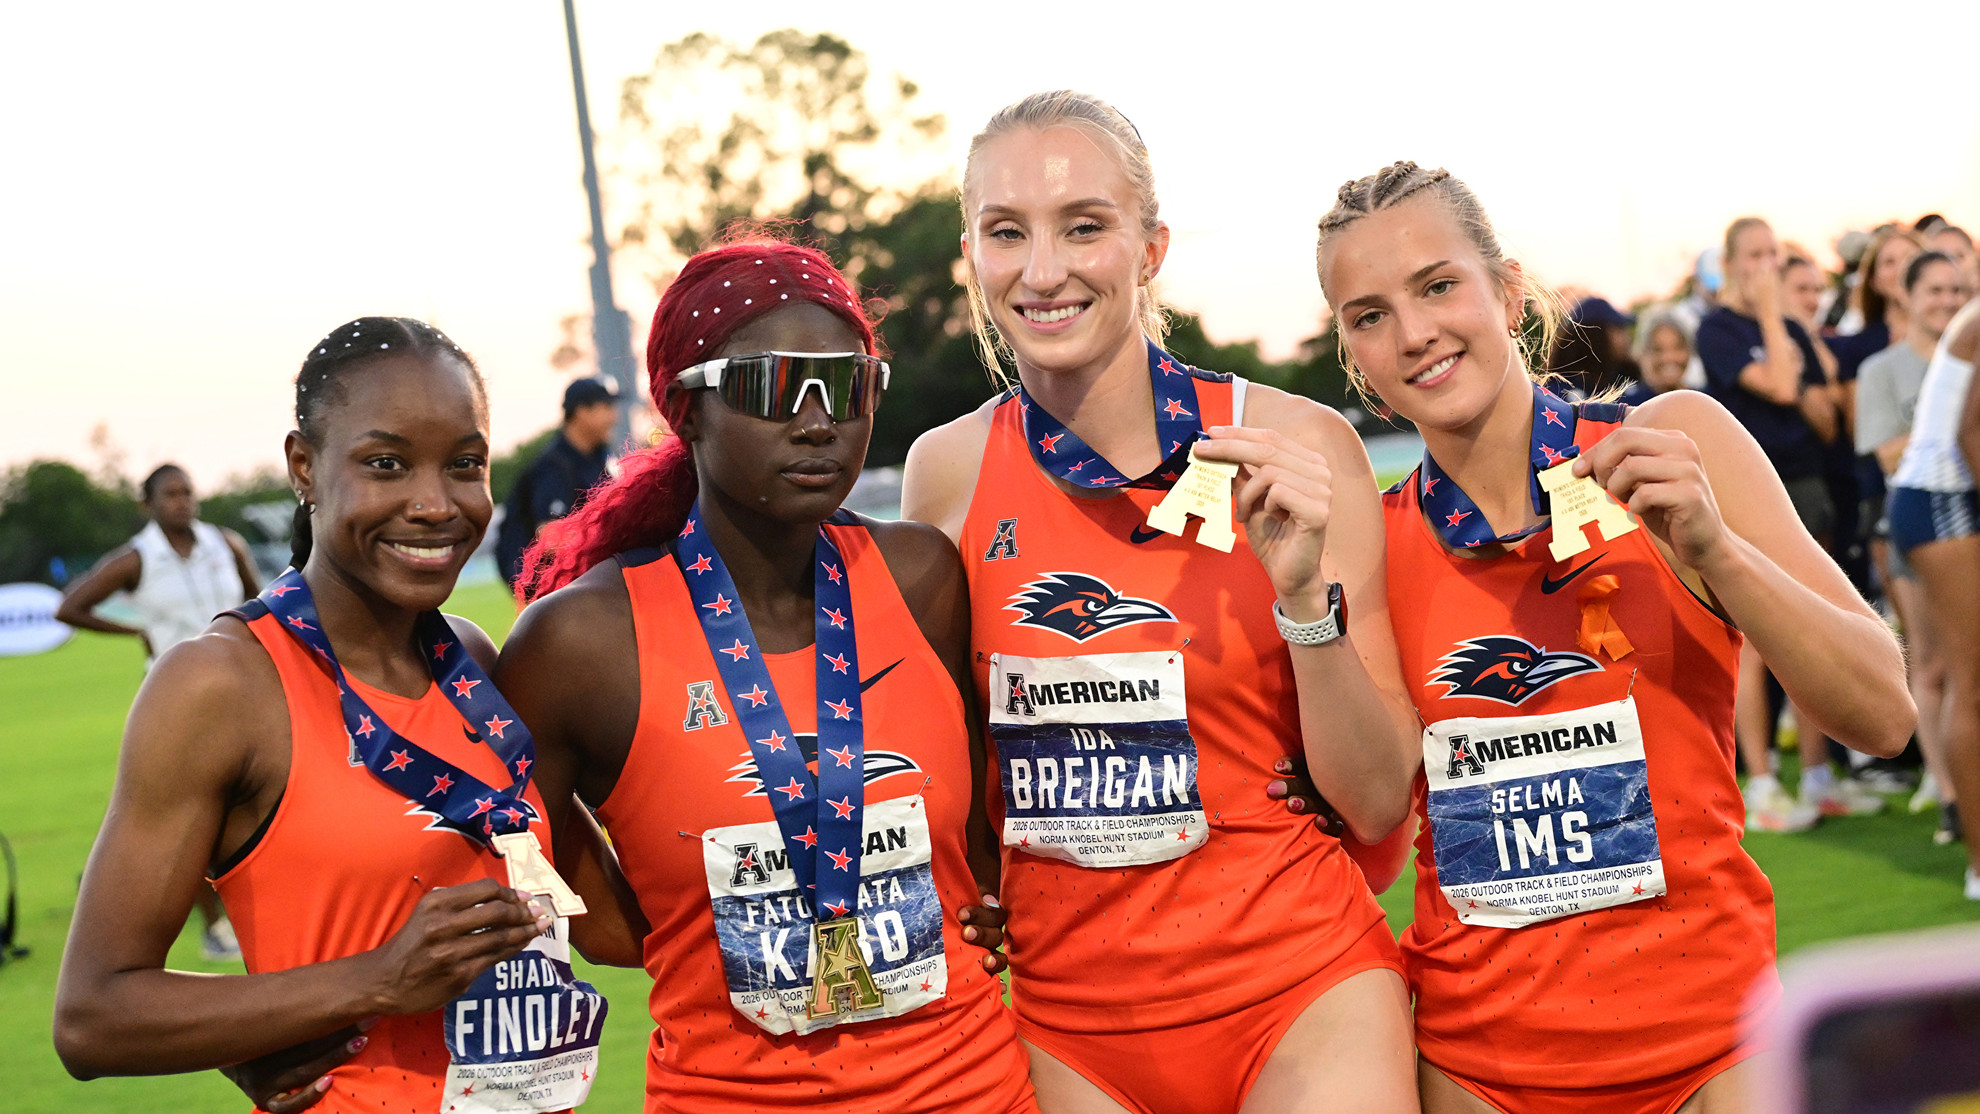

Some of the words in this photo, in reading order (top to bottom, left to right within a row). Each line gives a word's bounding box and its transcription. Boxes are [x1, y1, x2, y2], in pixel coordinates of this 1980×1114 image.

[1006, 673, 1160, 716] AMERICAN
[1069, 728, 1116, 751] IDA
[1446, 720, 1618, 779] AMERICAN
[1009, 754, 1190, 809] BREIGAN
[1491, 777, 1585, 814] SELMA
[1012, 821, 1028, 831] 2026
[1029, 820, 1064, 831] OUTDOOR
[1066, 820, 1092, 830] TRACK
[1094, 820, 1100, 830] &
[1102, 819, 1125, 830] FIELD
[1126, 814, 1196, 829] CHAMPIONSHIPS
[1039, 834, 1067, 844] NORMA
[1069, 833, 1102, 844] KNOBEL
[1104, 833, 1126, 842] HUNT
[1127, 830, 1165, 842] STADIUM
[1078, 846, 1115, 855] DENTON,
[1116, 845, 1126, 853] TX
[1494, 810, 1594, 871] IMS
[730, 826, 907, 887] AMAN
[1451, 886, 1470, 898] 2026
[1470, 882, 1514, 897] OUTDOOR
[1514, 879, 1545, 893] TRACK
[1547, 878, 1553, 888] &
[1554, 874, 1579, 887] FIELD
[1580, 865, 1653, 885] CHAMPIONSHIPS
[745, 876, 907, 927] FATOATA
[1486, 897, 1517, 907] NORMA
[1519, 893, 1554, 905] KNOBEL
[1555, 890, 1580, 902] HUNT
[1581, 885, 1619, 898] STADIUM
[1529, 905, 1567, 916] DENTON,
[1568, 902, 1580, 911] TX
[873, 959, 938, 987] CHAMPIONSHIPS
[741, 993, 761, 1004] 2026
[878, 983, 909, 995] ADIUM
[455, 990, 601, 1057] FINDLEY
[457, 1069, 476, 1078] 2026
[477, 1066, 512, 1078] OUTDOOR
[514, 1065, 536, 1075] TRACK
[554, 1051, 593, 1068] CHAMPIONSHIPS
[485, 1082, 513, 1090] NORMA
[553, 1070, 574, 1083] STADIUM
